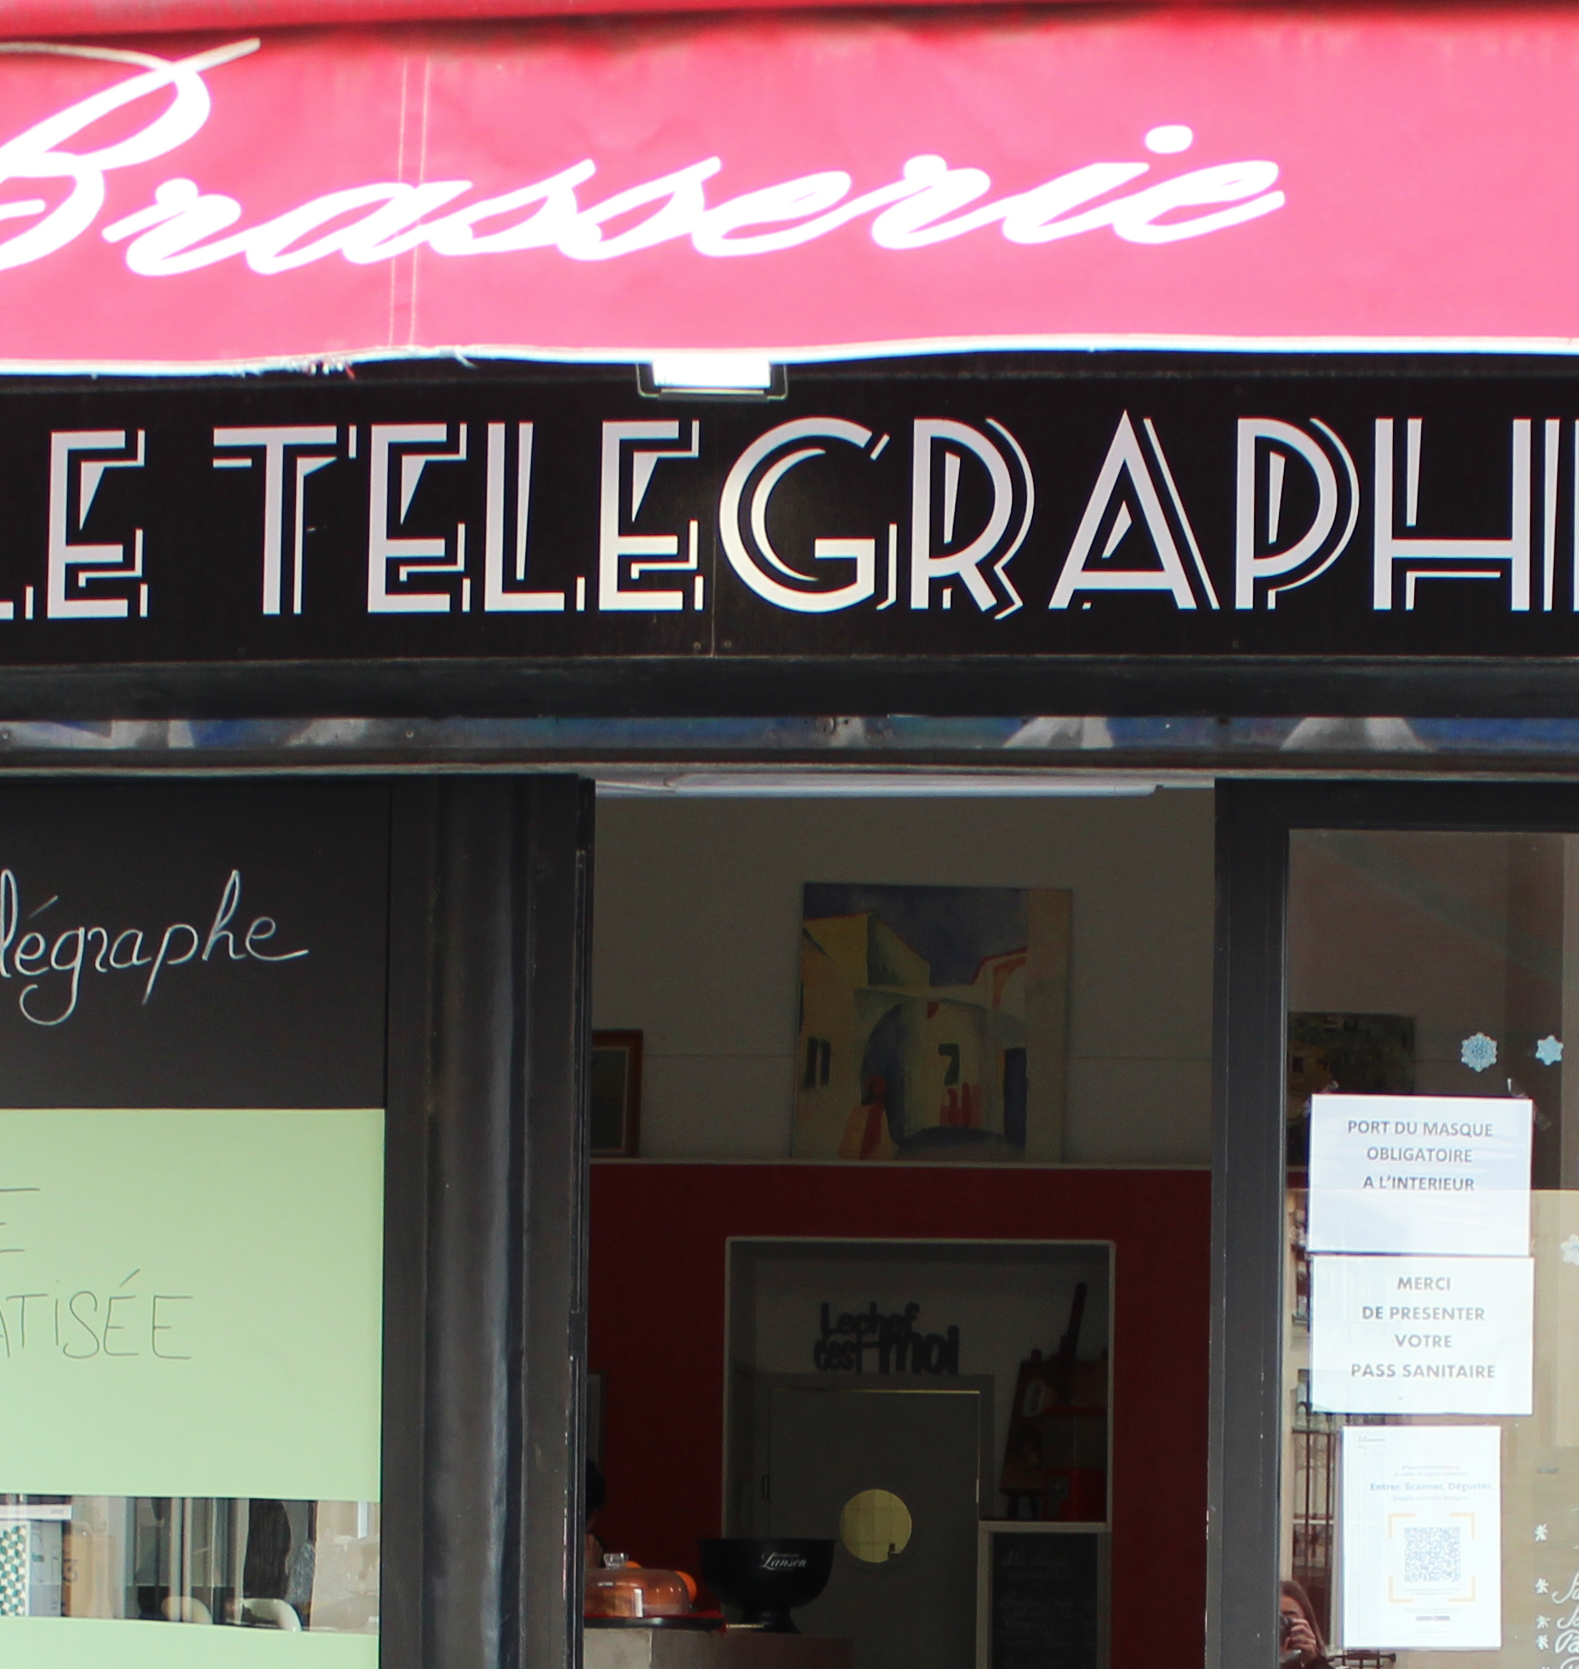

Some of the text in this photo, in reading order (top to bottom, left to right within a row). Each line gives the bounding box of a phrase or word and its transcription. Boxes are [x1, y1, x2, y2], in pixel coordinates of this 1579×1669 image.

[1347, 1120, 1493, 1138] PORT DU MASQUE
[1367, 1147, 1473, 1163] OBLIGATOIRE
[1362, 1175, 1475, 1191] A L'INTERIEUR
[1397, 1276, 1451, 1291] MERCI
[1362, 1306, 1485, 1321] DE PRESENTER
[1394, 1334, 1452, 1348] VOTRE
[1351, 1363, 1495, 1379] PASS SANITAIRE
[1370, 1482, 1494, 1492] Entrer. Scanner. Déguster.
[759, 1552, 807, 1571] Lanson
